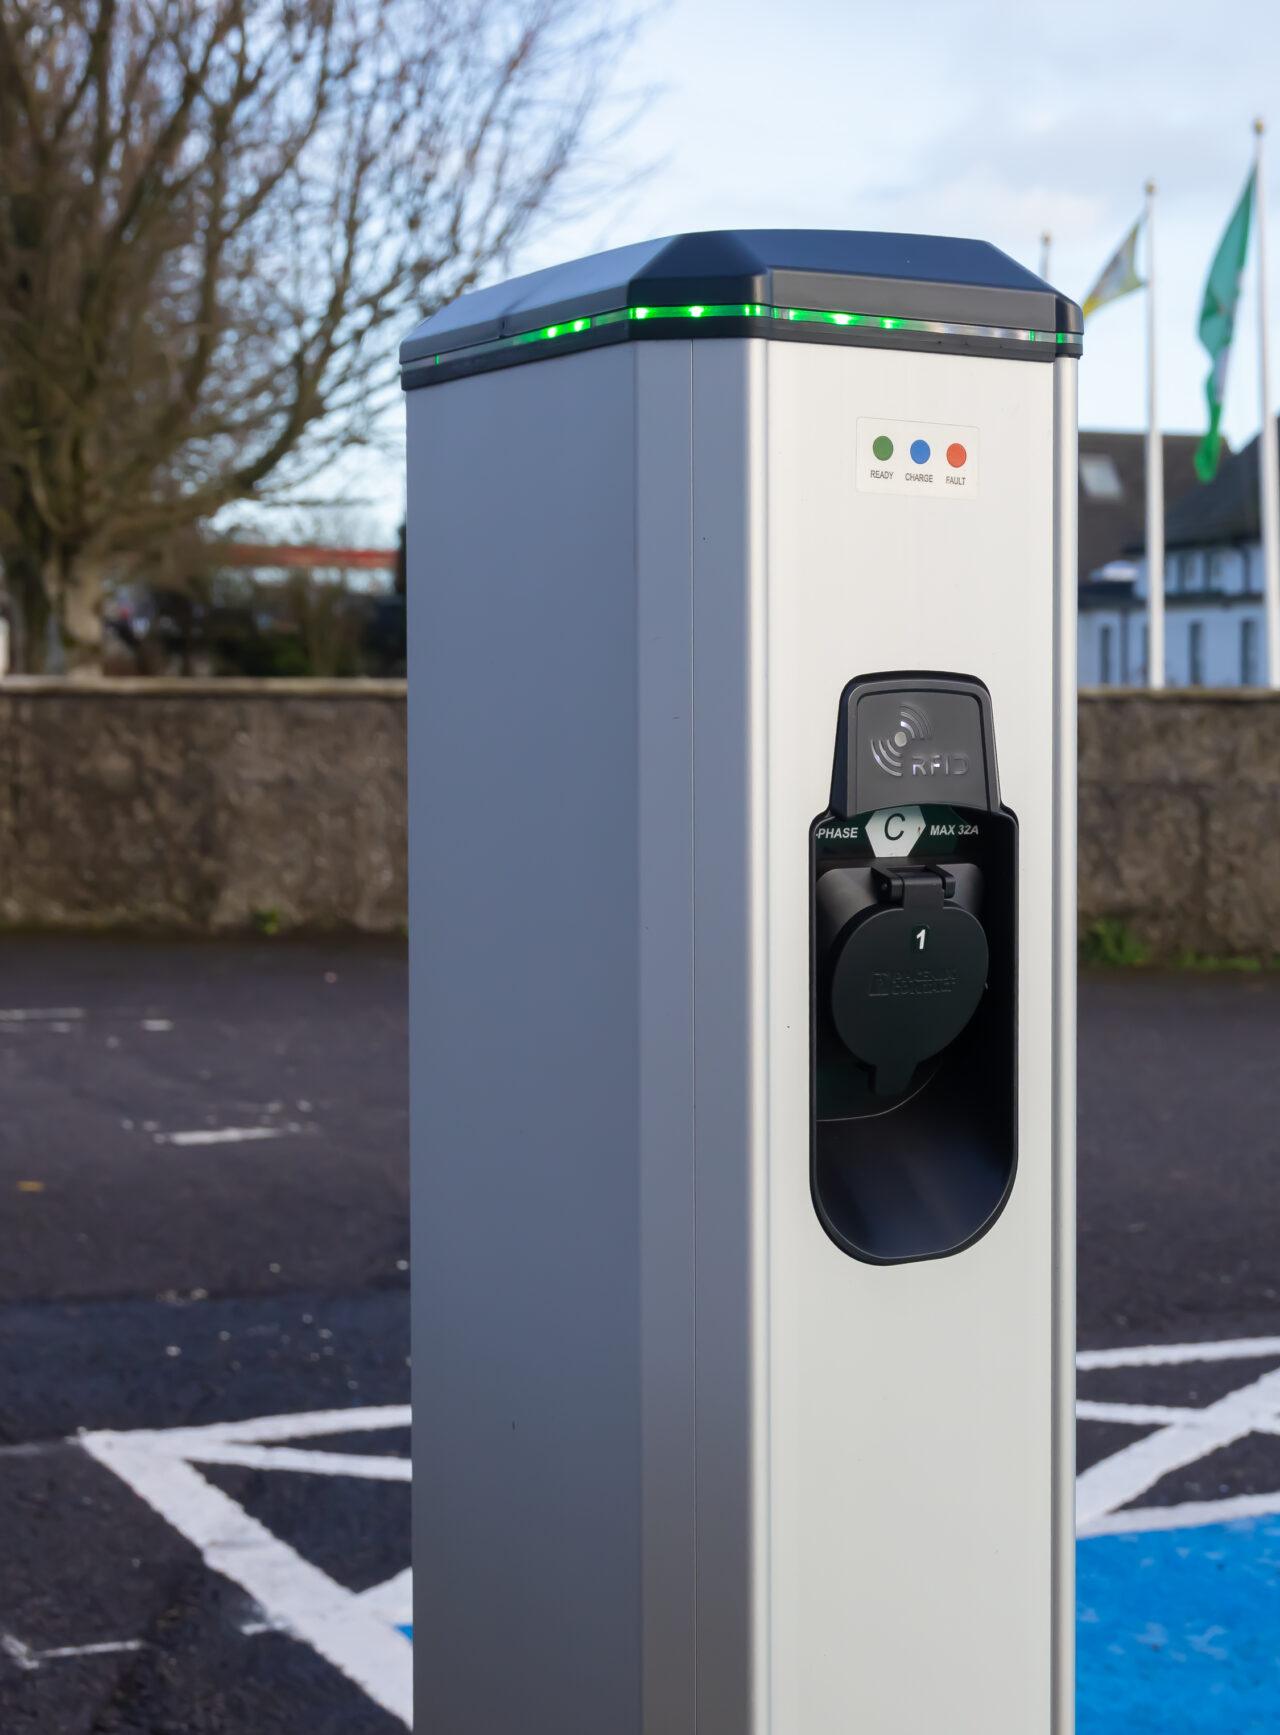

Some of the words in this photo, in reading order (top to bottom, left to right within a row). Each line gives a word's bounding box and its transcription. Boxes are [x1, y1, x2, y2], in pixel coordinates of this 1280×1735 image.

[870, 469, 894, 480] READY
[904, 472, 934, 483] CHARGE
[945, 475, 966, 486] FAULT
[911, 752, 970, 776] RFID
[884, 812, 906, 841] C
[930, 824, 955, 836] MAX
[957, 823, 979, 836] 32A
[916, 929, 926, 950] 1
